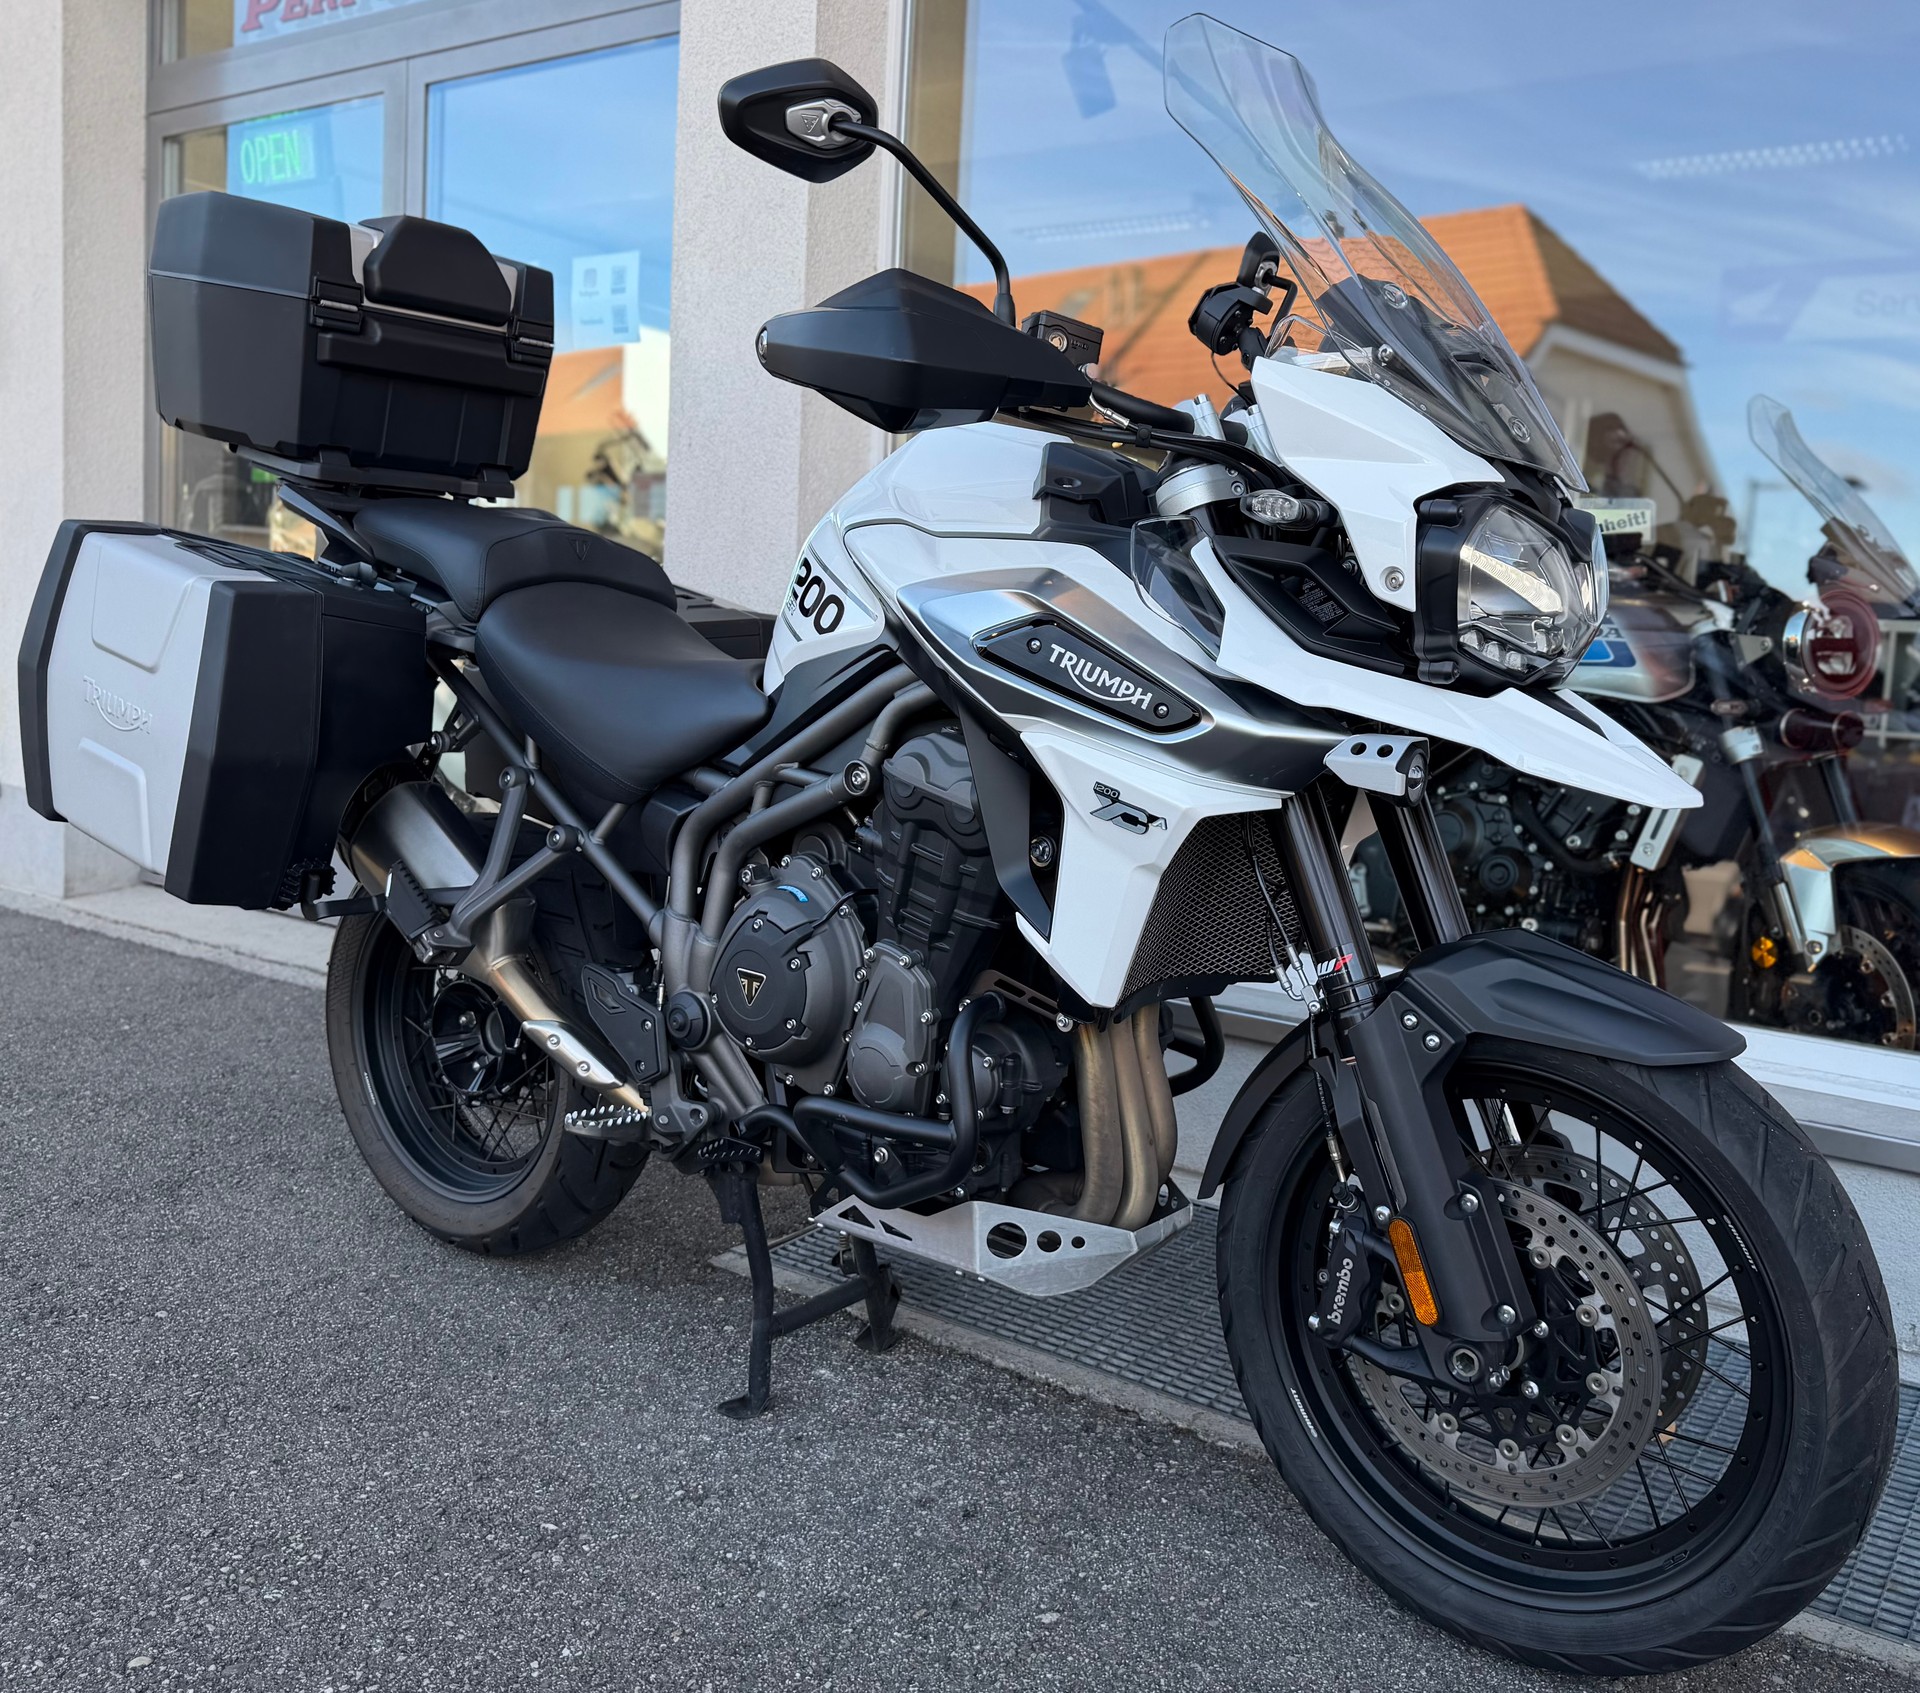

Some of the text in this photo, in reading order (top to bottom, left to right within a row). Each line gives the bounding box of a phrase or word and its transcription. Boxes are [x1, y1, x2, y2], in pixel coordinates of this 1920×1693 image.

[241, 129, 301, 184] OPEN
[82, 674, 153, 735] TRIUMPH
[1049, 643, 1153, 710] TRIUMPH
[1093, 782, 1120, 799] 1200
[1326, 1257, 1354, 1325] brembo
